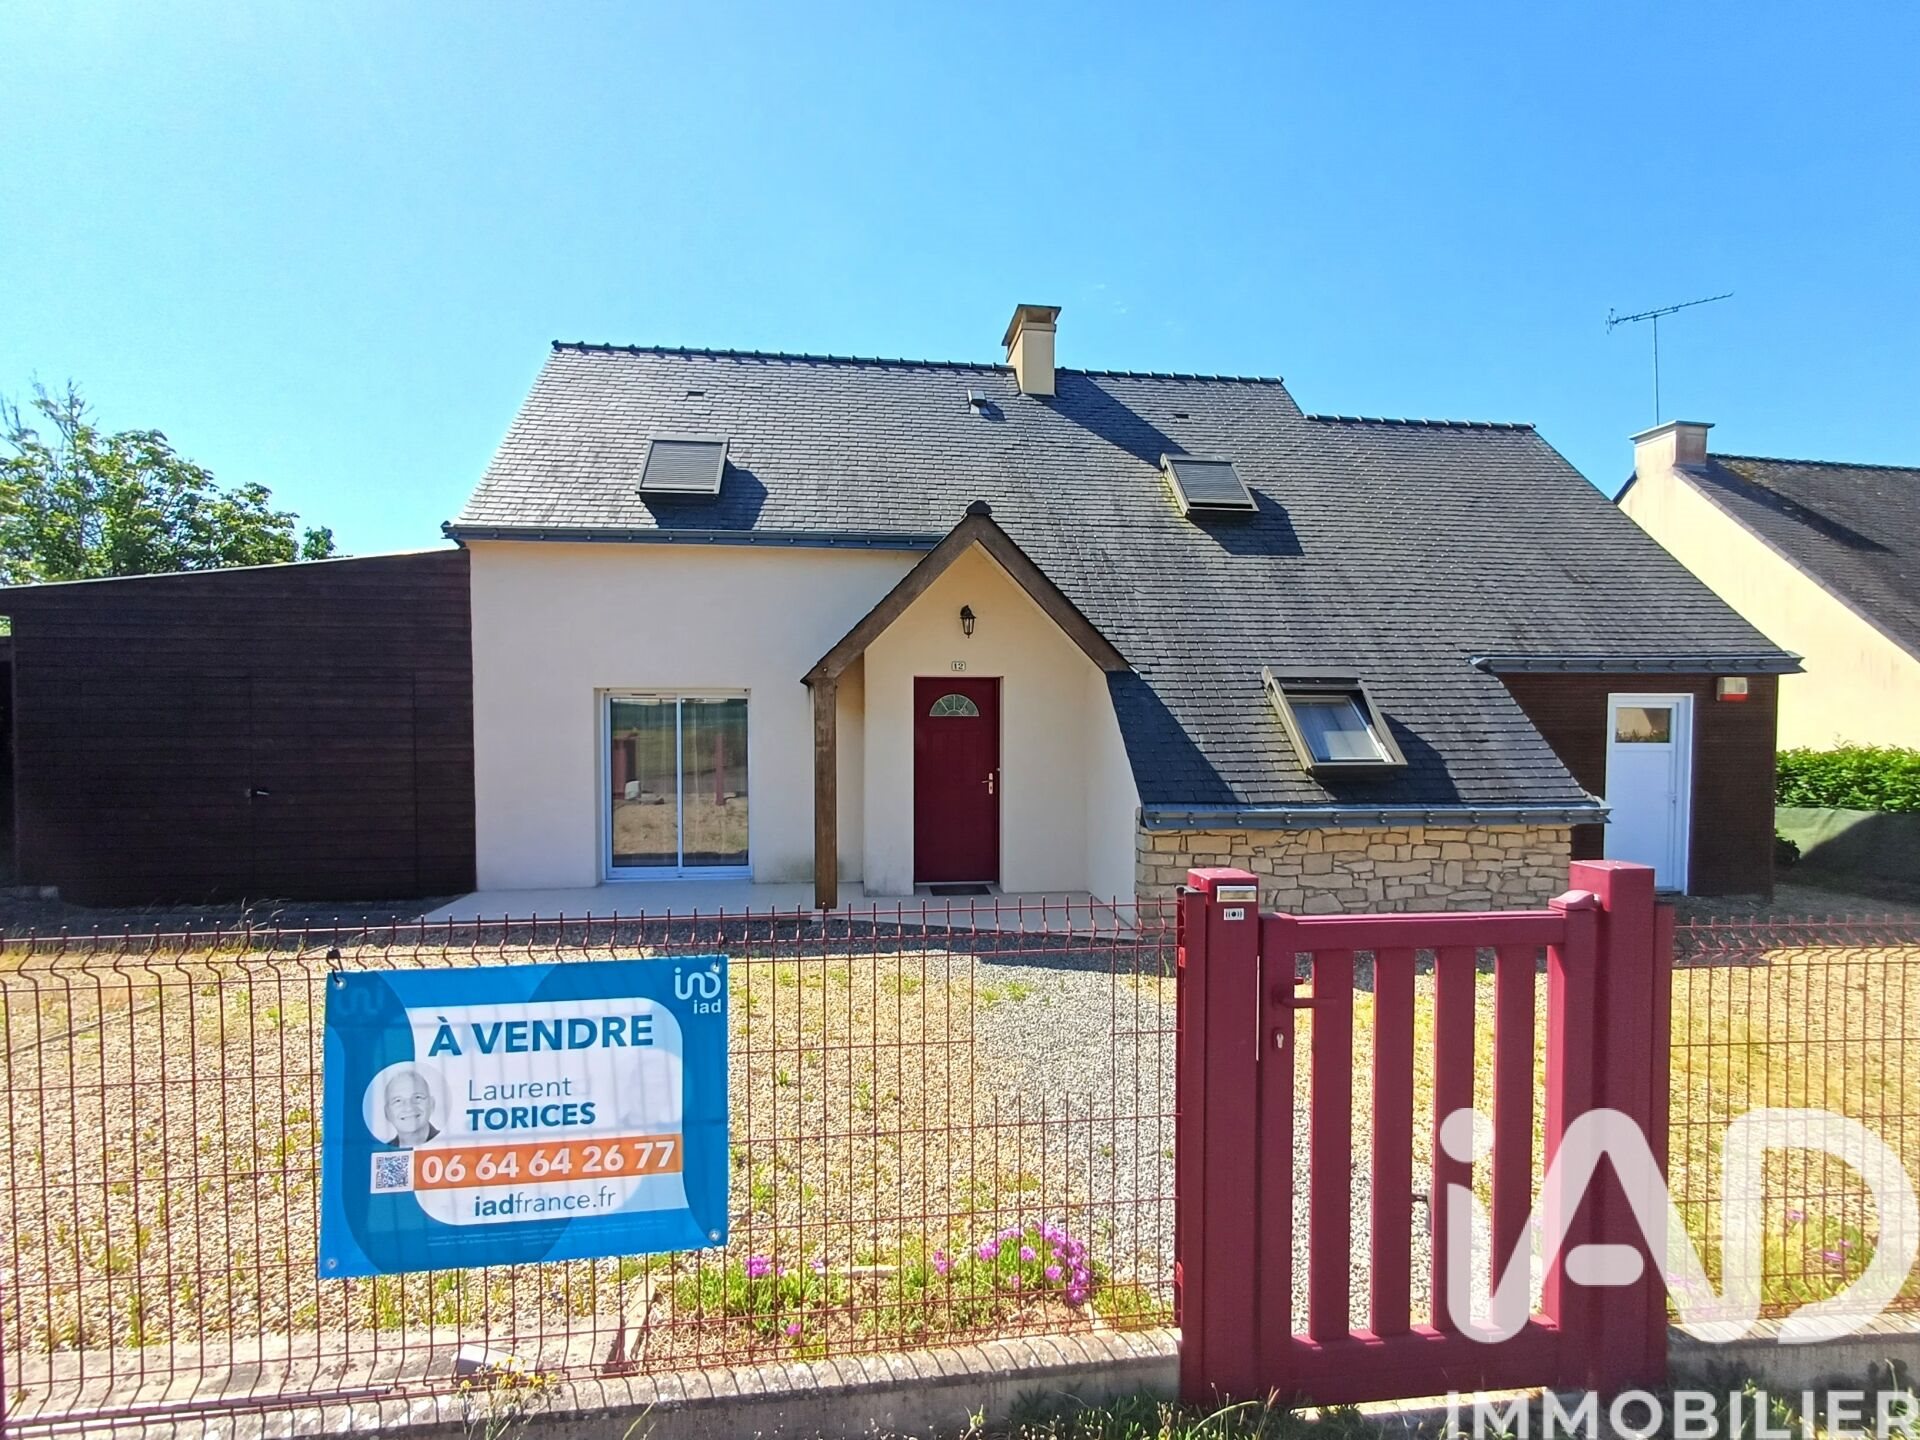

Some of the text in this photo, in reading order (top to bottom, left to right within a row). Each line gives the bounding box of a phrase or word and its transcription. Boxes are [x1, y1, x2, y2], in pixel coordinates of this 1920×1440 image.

[693, 999, 721, 1014] iad
[428, 1014, 653, 1057] À VENDRE
[469, 1076, 572, 1102] Laurent
[466, 1102, 596, 1132] TORICES
[421, 1140, 676, 1184] 06 64 64 26 77
[474, 1186, 616, 1218] iadfrance.fr
